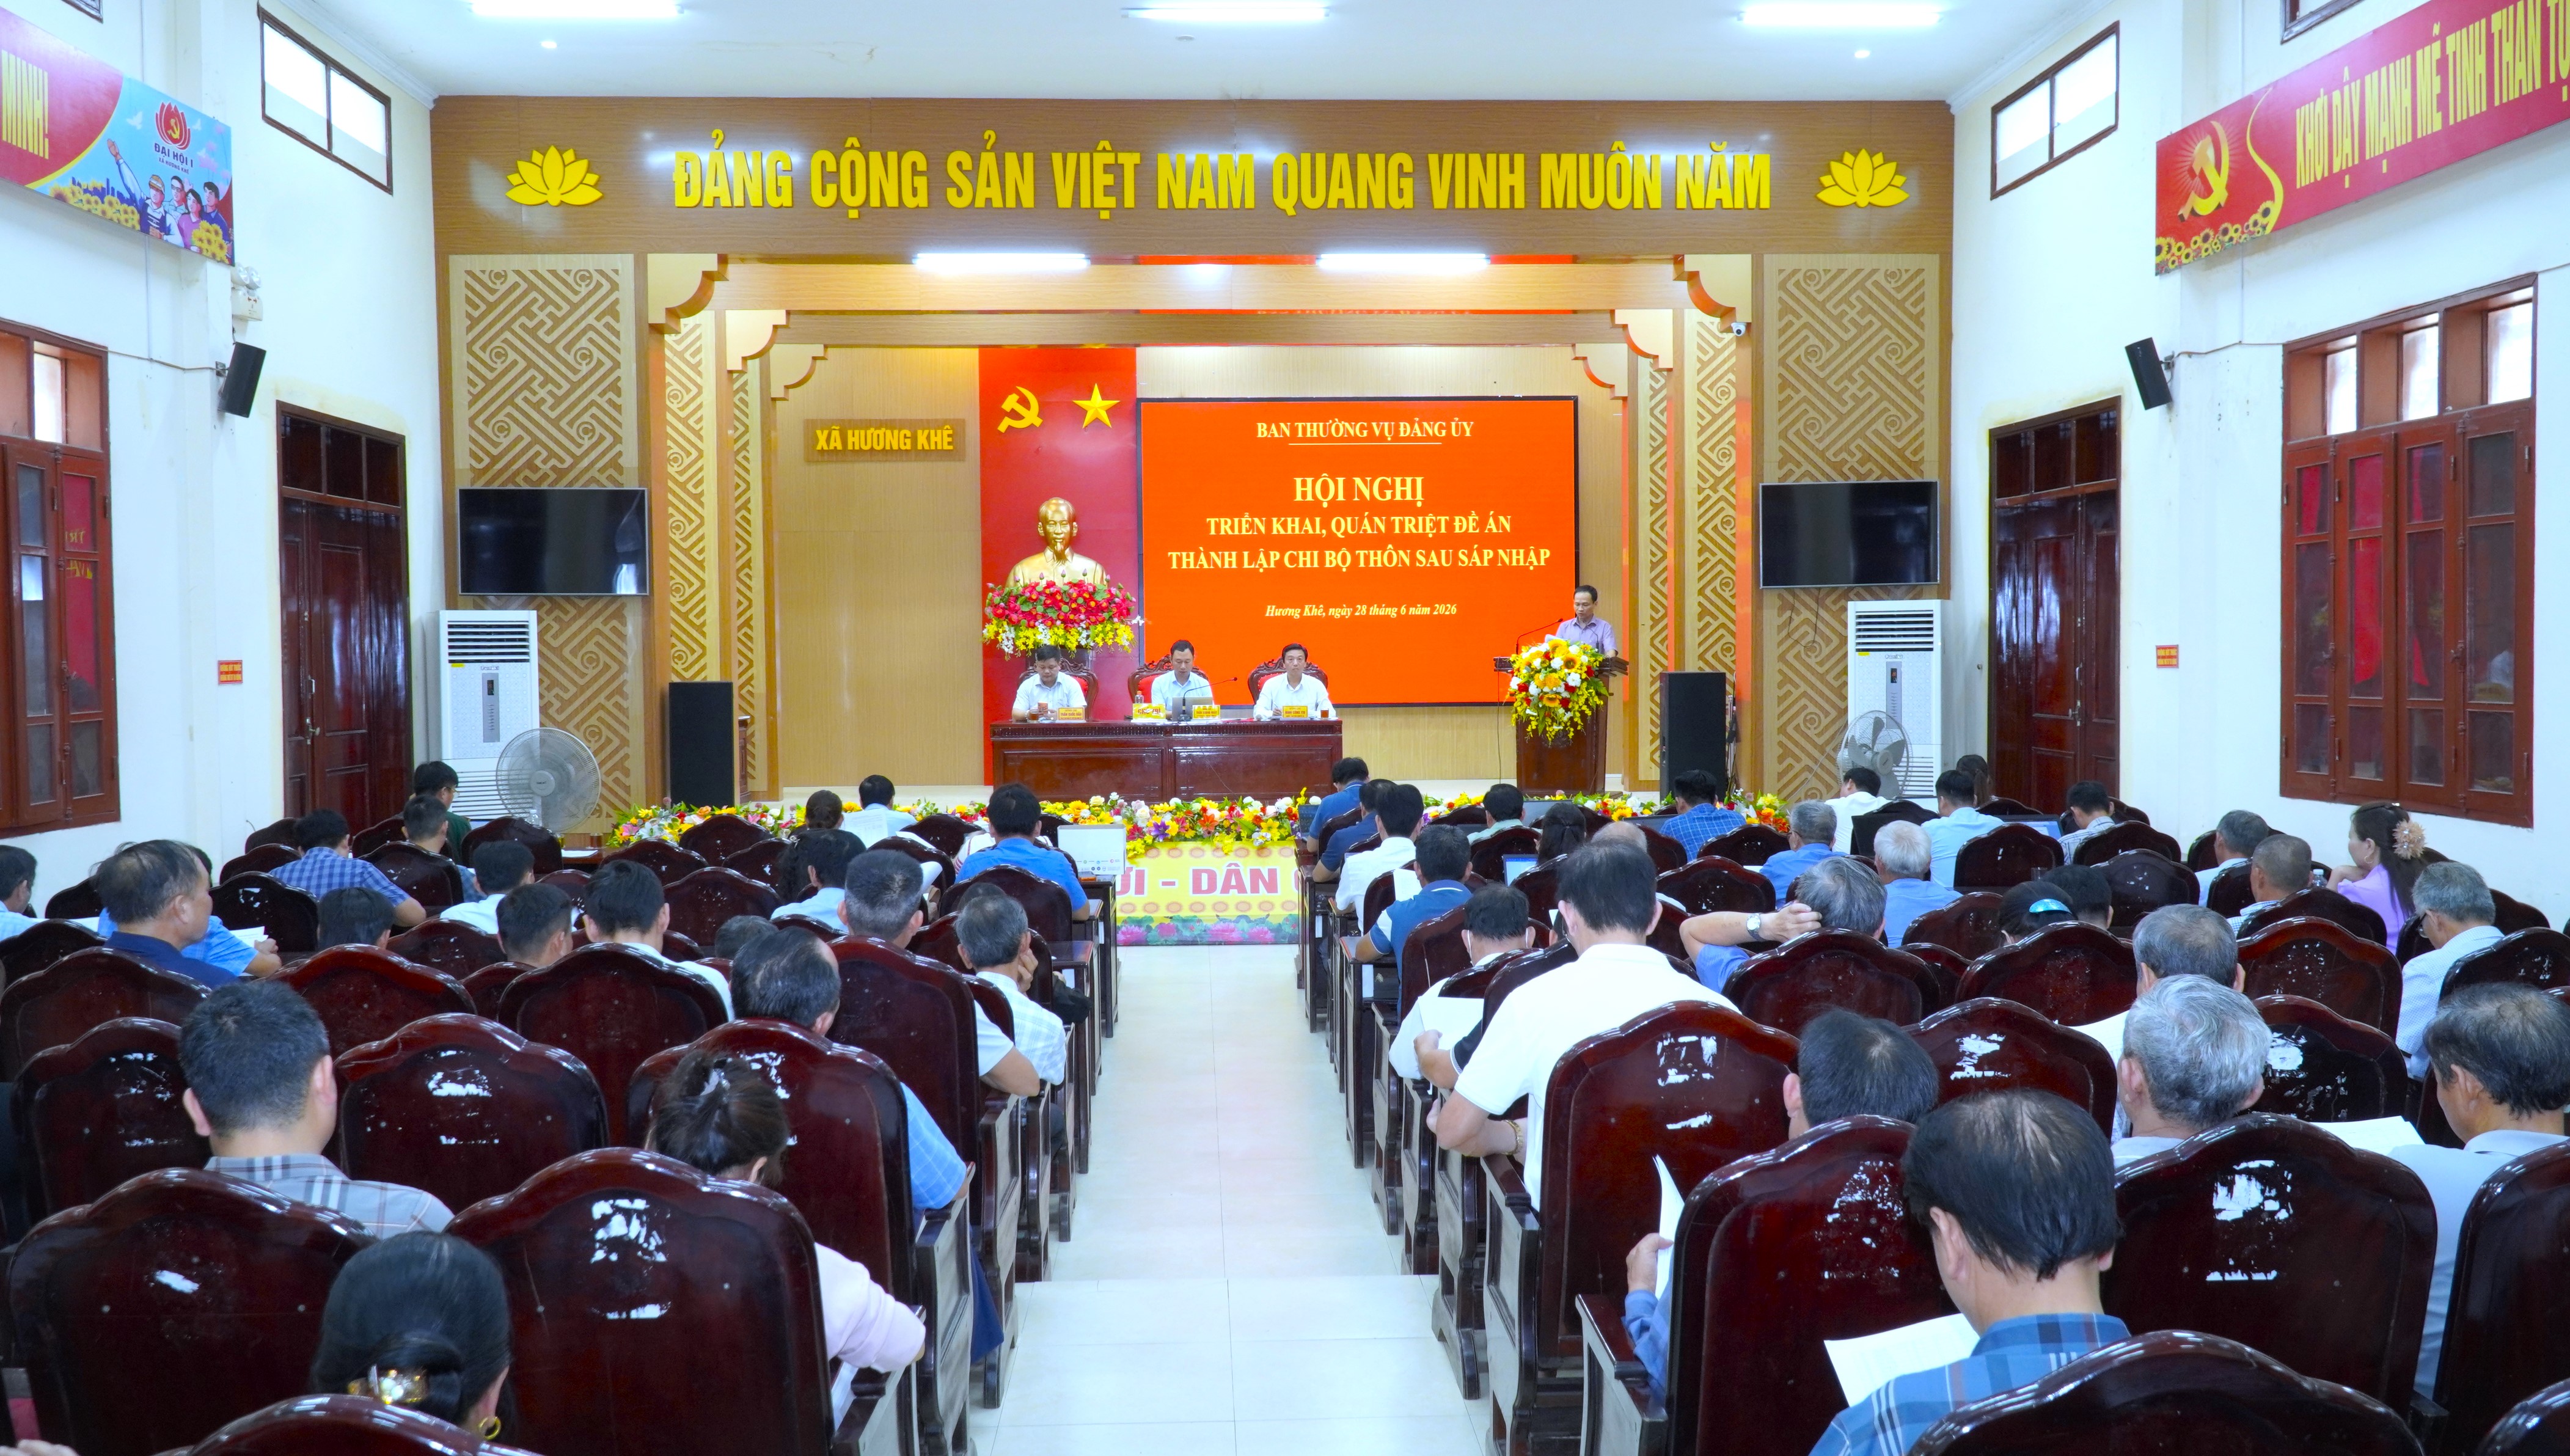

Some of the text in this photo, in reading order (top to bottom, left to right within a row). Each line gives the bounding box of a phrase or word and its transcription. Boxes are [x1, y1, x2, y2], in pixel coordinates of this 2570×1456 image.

[2, 49, 49, 159] MINH!
[2332, 65, 2360, 188] DẬY
[2365, 54, 2412, 174] MẠNH
[2416, 21, 2442, 139] MẼ
[2446, 18, 2487, 126] TINH
[155, 143, 170, 158] ĐẠI
[173, 151, 188, 166] HỘI
[673, 130, 1771, 219] ĐẢNG CỘNG SẢN VIỆT NAM QUANG VINH MUÔN NĂM
[816, 425, 954, 450] XÃ HƯƠNG KHÊ
[1256, 417, 1474, 441] BAN THƯỜNG VỤ ĐẢNG ỦY
[1294, 473, 1425, 508] HỘI NGHỊ
[1206, 510, 1512, 538] TRIỂN KHAI, QUÁN TRIỆT ĐỀ ÁN
[1168, 544, 1551, 573] THÀNH LẬP CHI BỘ THÔN SAU SÁP NHẬP
[1265, 604, 1457, 620] Hương Khê, ngày 28 tháng 6 năm 2026
[1192, 863, 1278, 894] DÂN
